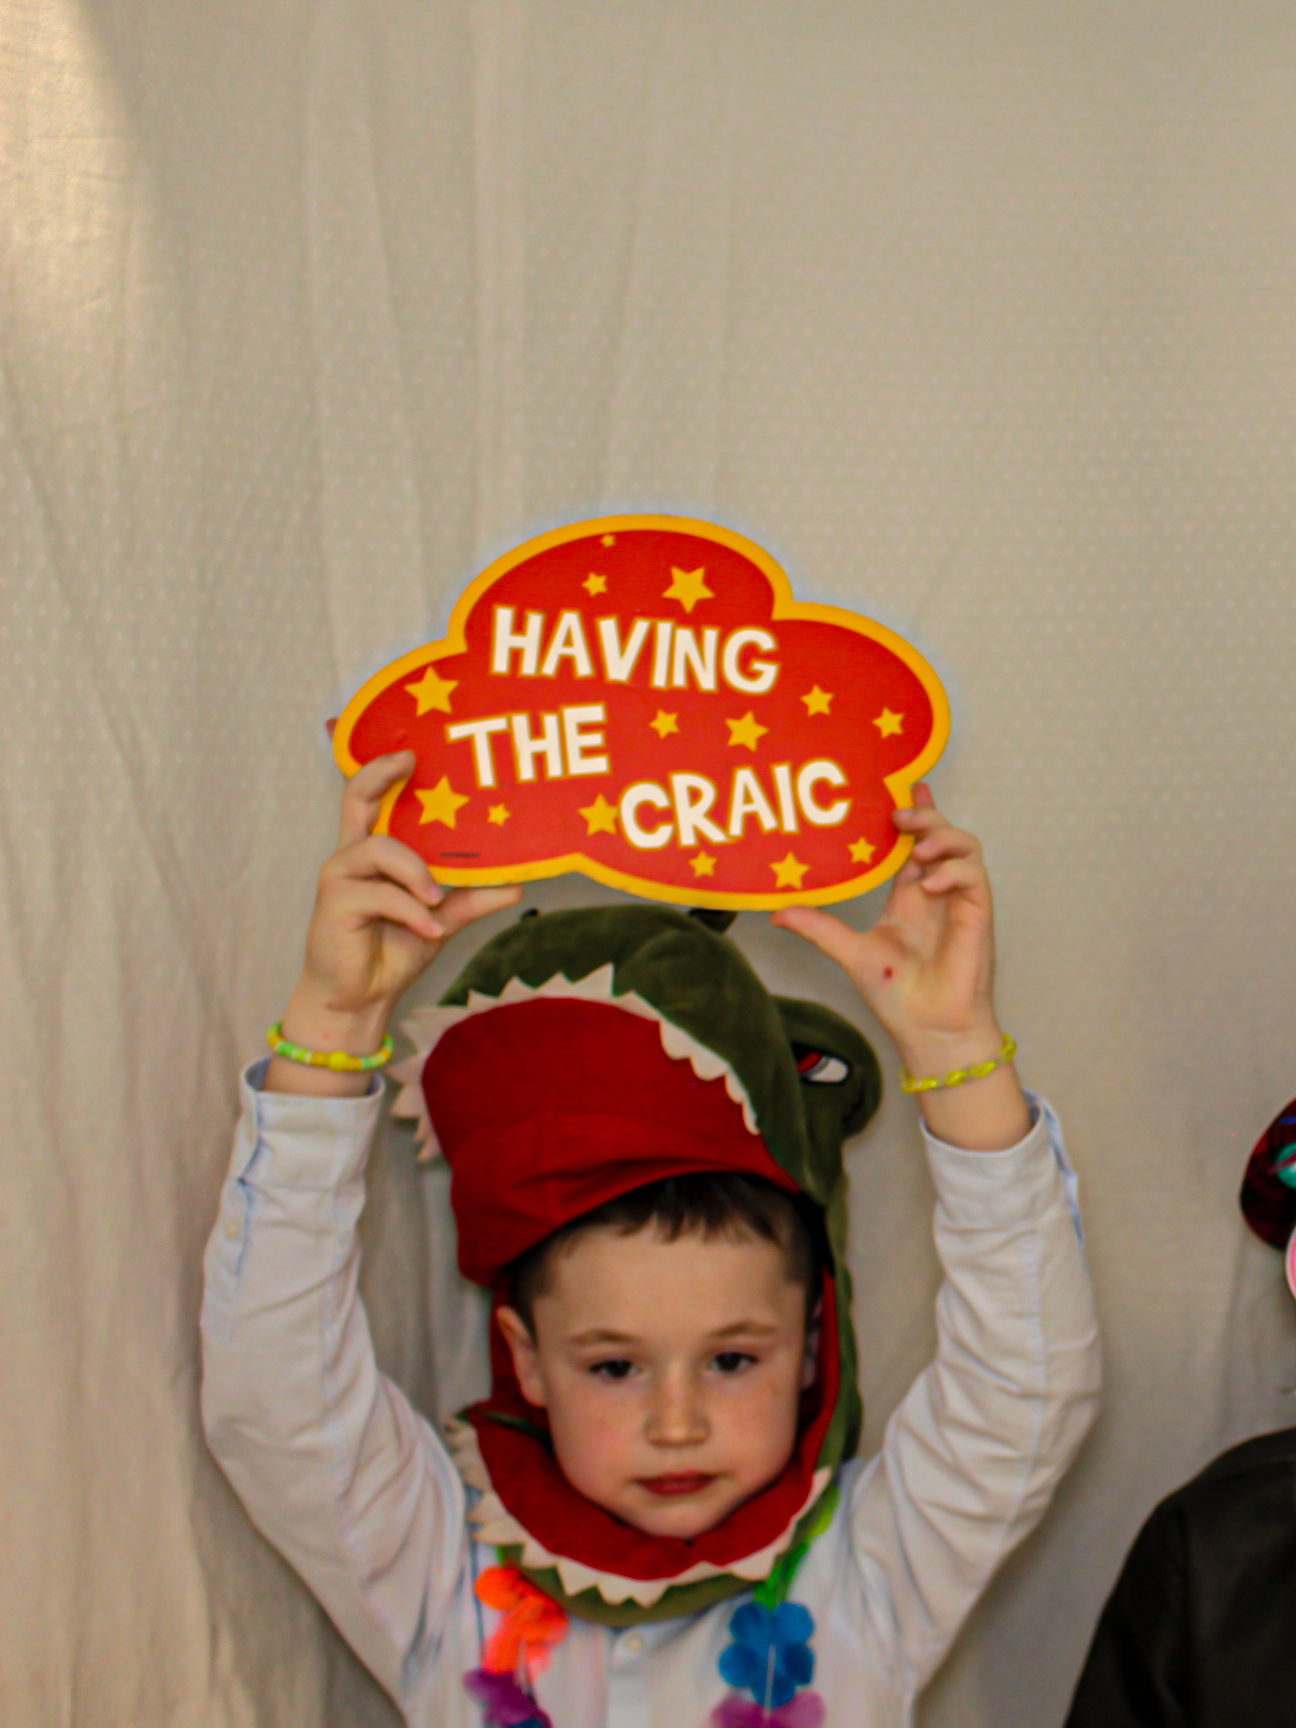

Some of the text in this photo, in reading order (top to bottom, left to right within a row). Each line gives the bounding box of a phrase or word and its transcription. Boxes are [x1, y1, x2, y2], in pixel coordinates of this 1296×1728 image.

[491, 606, 779, 693] HAVING
[447, 705, 610, 787] THE
[619, 760, 850, 850] CRAIC
